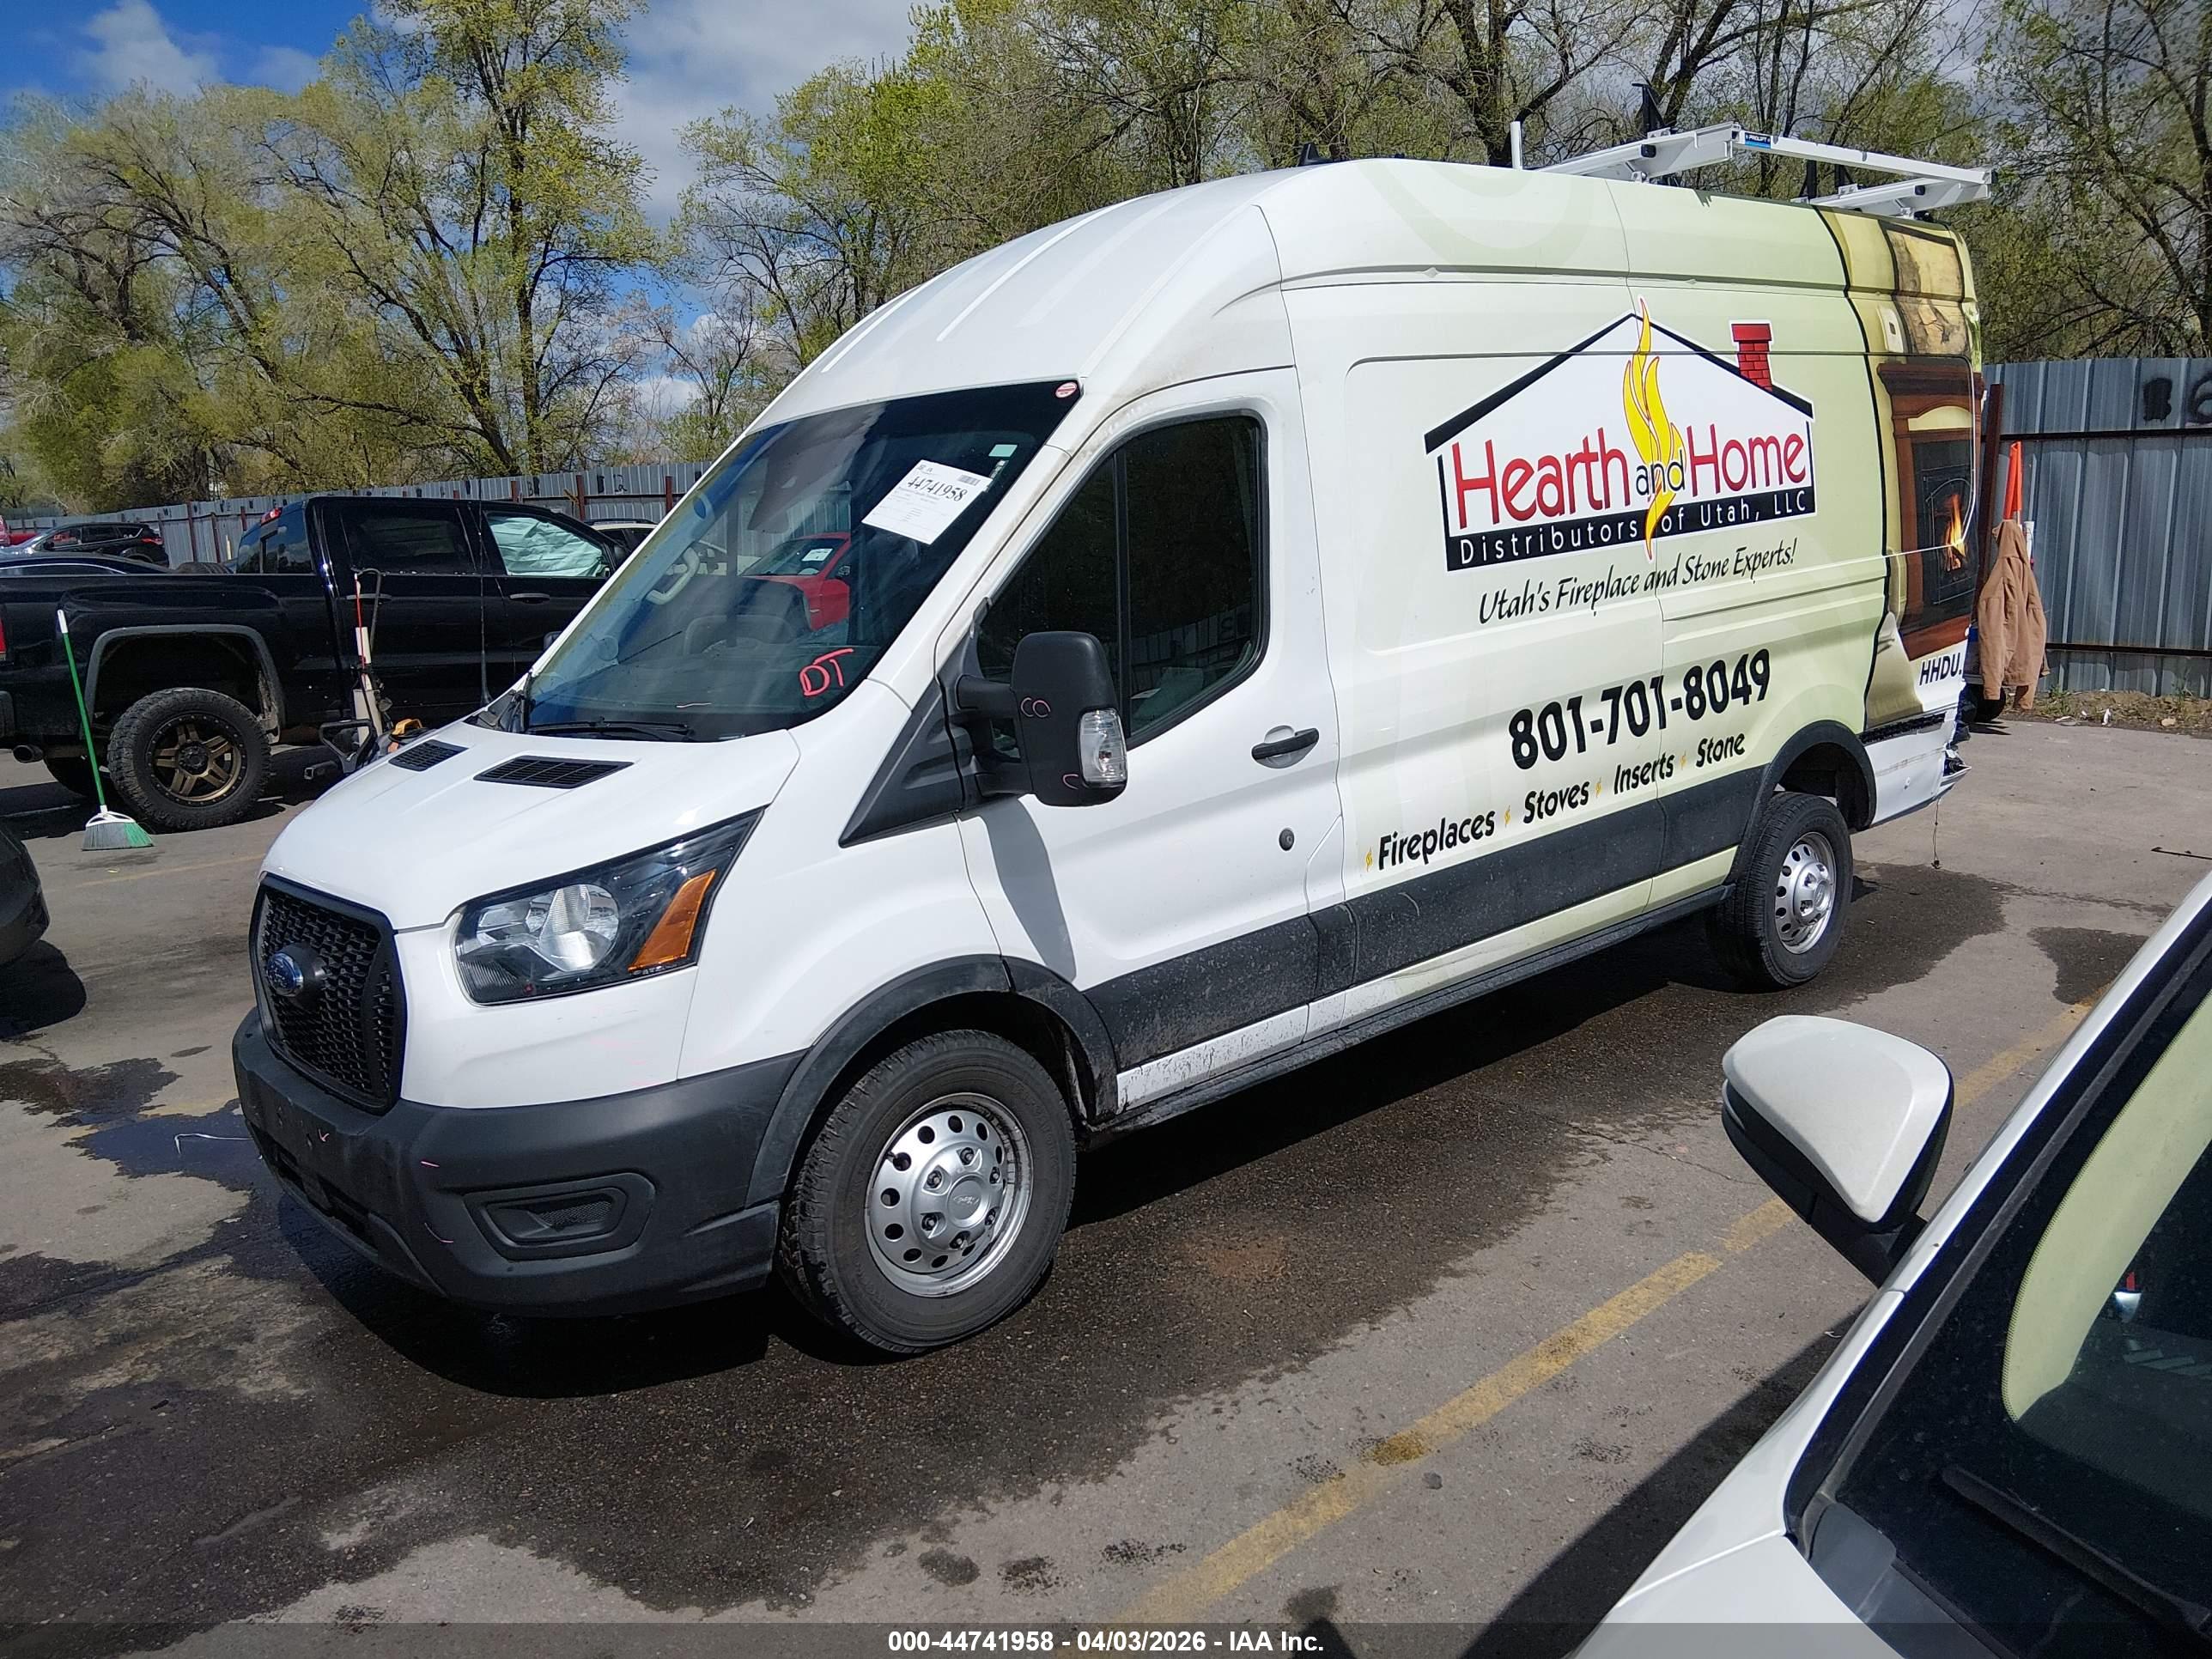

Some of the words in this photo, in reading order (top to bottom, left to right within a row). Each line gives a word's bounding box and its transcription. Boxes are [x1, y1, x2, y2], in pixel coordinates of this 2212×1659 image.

[908, 476, 968, 501] 44741958
[1452, 428, 1631, 529] Hearth
[1636, 450, 1685, 495] and
[1687, 424, 1806, 497] Home
[1461, 520, 1638, 564] Distributors
[1662, 508, 1685, 532] of
[1700, 502, 1759, 526] Utah,
[1773, 490, 1806, 515] LLC
[1479, 578, 1550, 624] Utah's
[1556, 564, 1641, 617] Fireplace
[1644, 553, 1679, 592] and
[1681, 554, 1729, 586] Stone
[1733, 538, 1797, 584] Experts!
[799, 647, 854, 696] DT
[1509, 648, 1770, 770] 801-701-8049
[1378, 809, 1495, 871] Fireplaces
[1523, 781, 1589, 824] Stoves
[1613, 752, 1674, 795] Inserts
[1695, 732, 1745, 768] Stone
